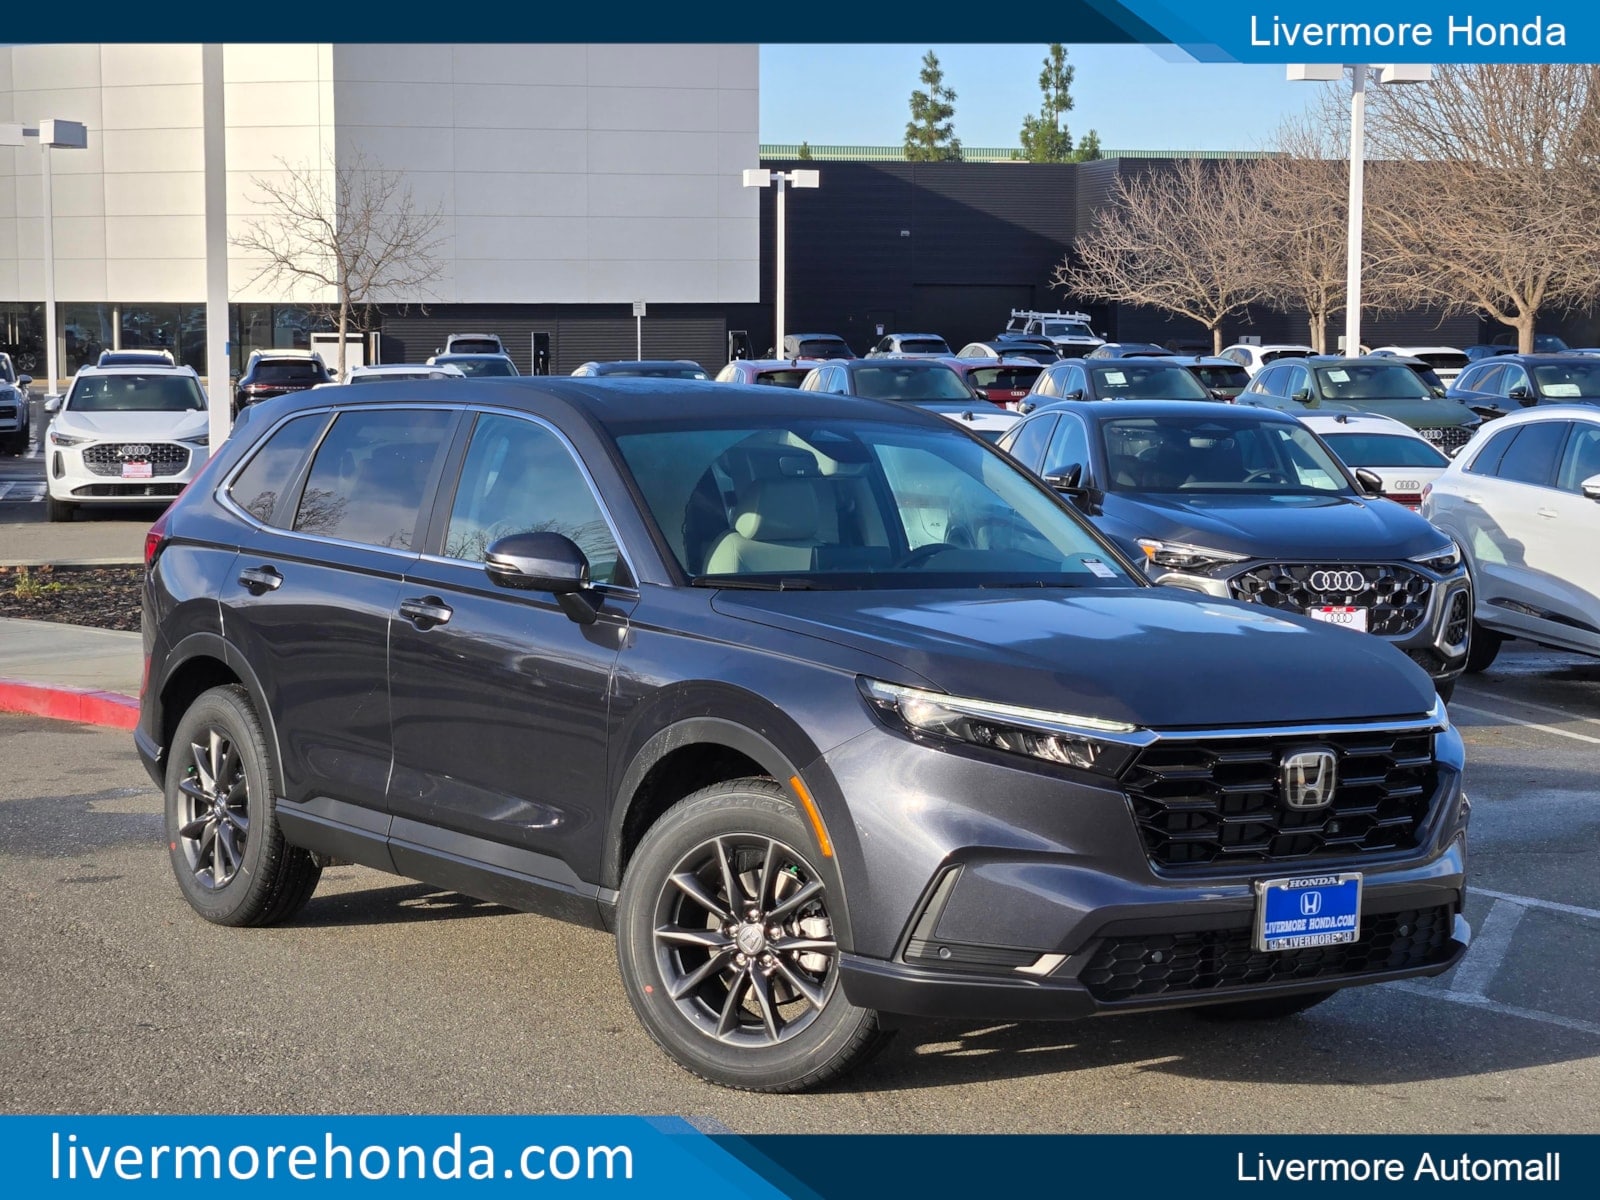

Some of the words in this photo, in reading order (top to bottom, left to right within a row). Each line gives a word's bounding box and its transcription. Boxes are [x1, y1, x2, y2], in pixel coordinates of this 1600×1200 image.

[1289, 877, 1337, 888] HONDA
[1265, 919, 1306, 934] LIVERMORE
[1309, 914, 1356, 930] HONDA.COM
[1284, 933, 1337, 948] LIVERMORE
